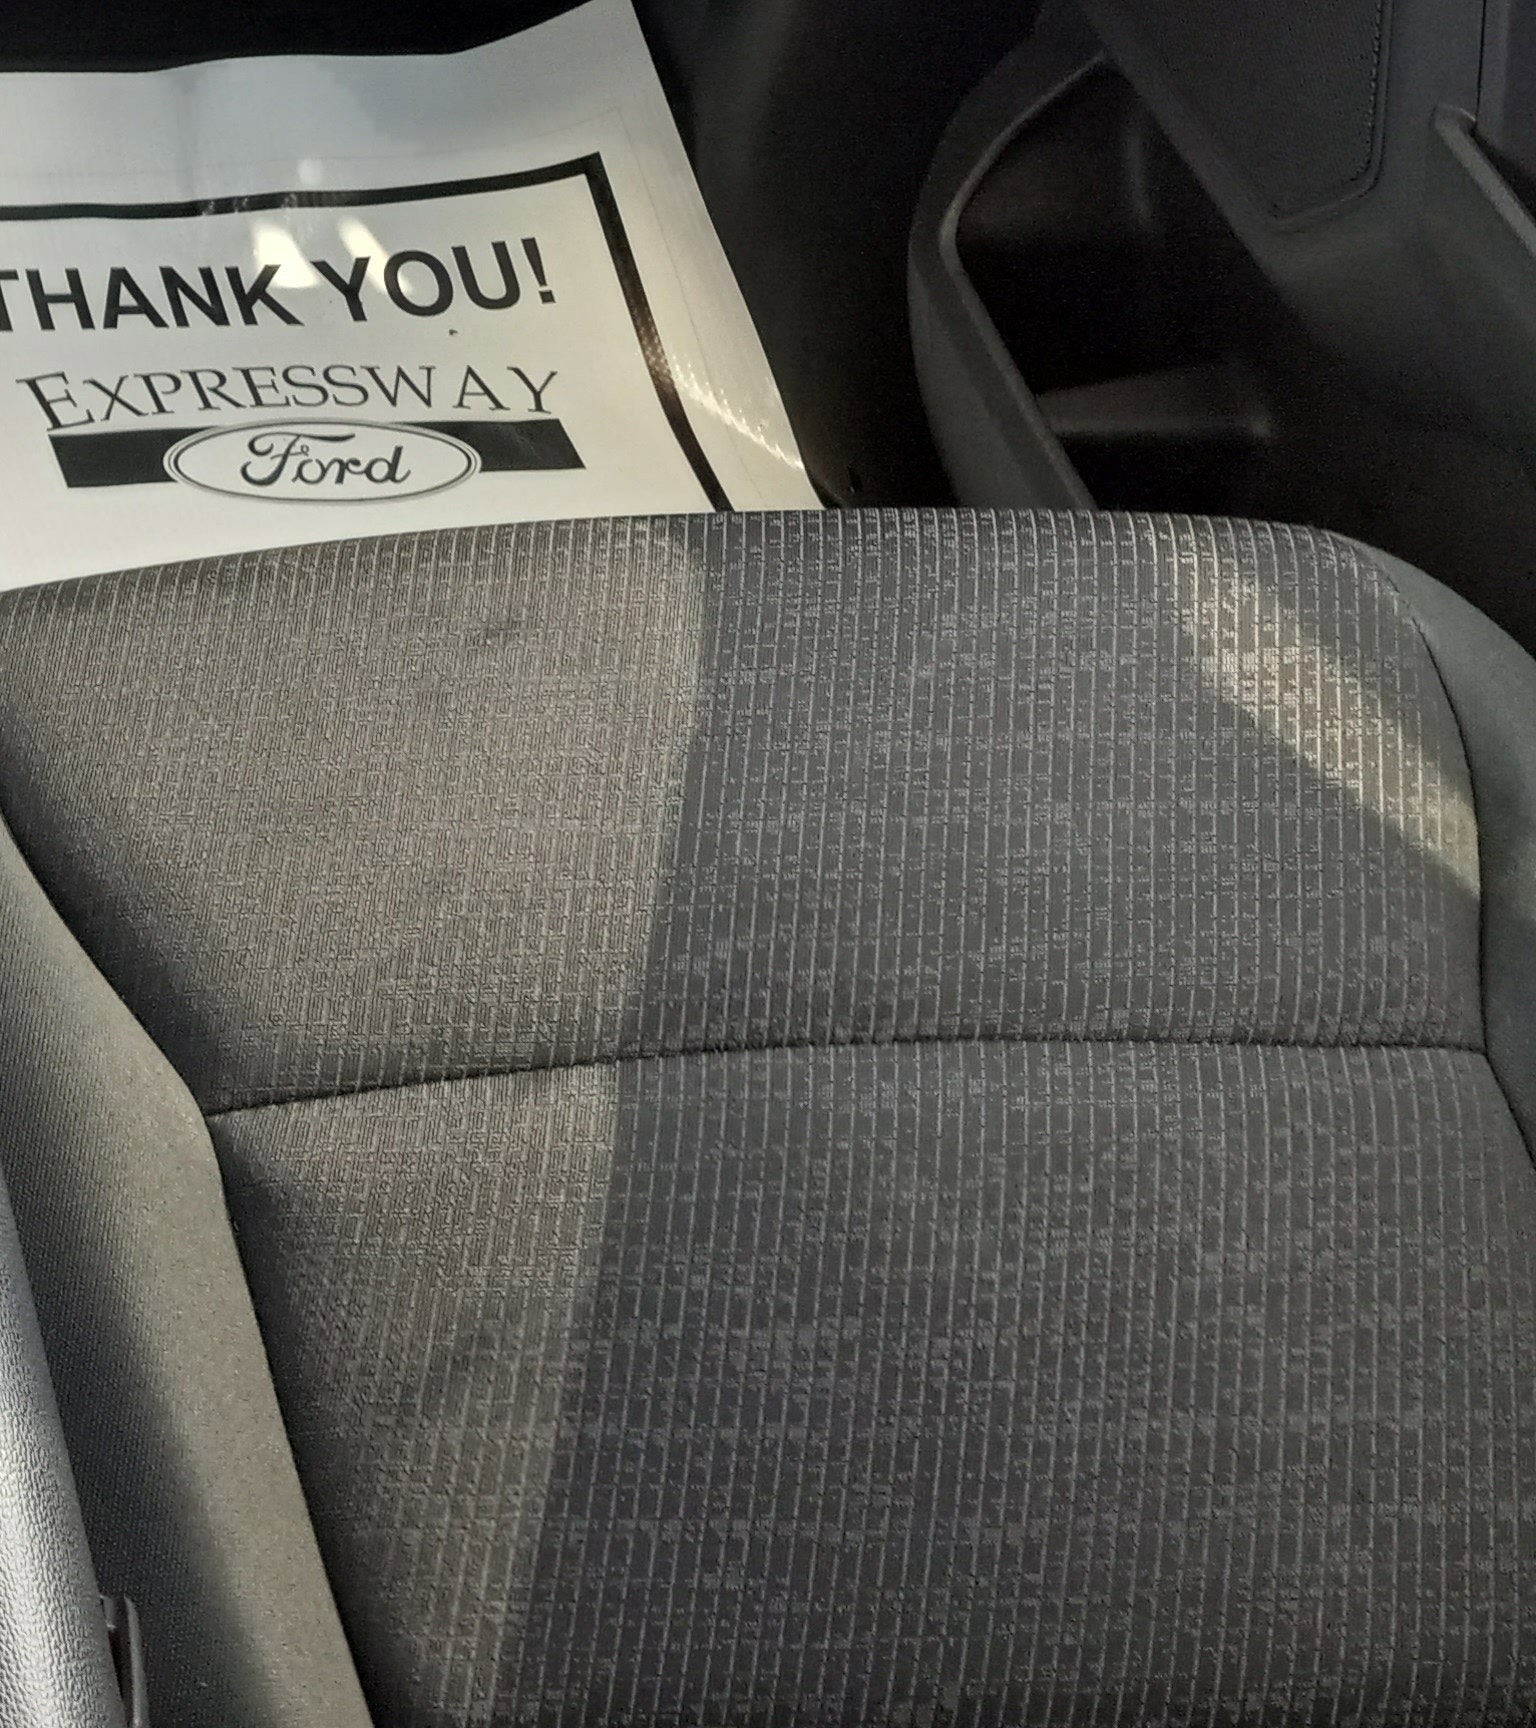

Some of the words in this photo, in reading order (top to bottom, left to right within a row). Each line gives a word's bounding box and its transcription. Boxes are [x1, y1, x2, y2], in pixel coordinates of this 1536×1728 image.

[310, 237, 556, 322] YOU!
[16, 363, 558, 431] EXPRESSWAY
[240, 431, 411, 486] Ford
